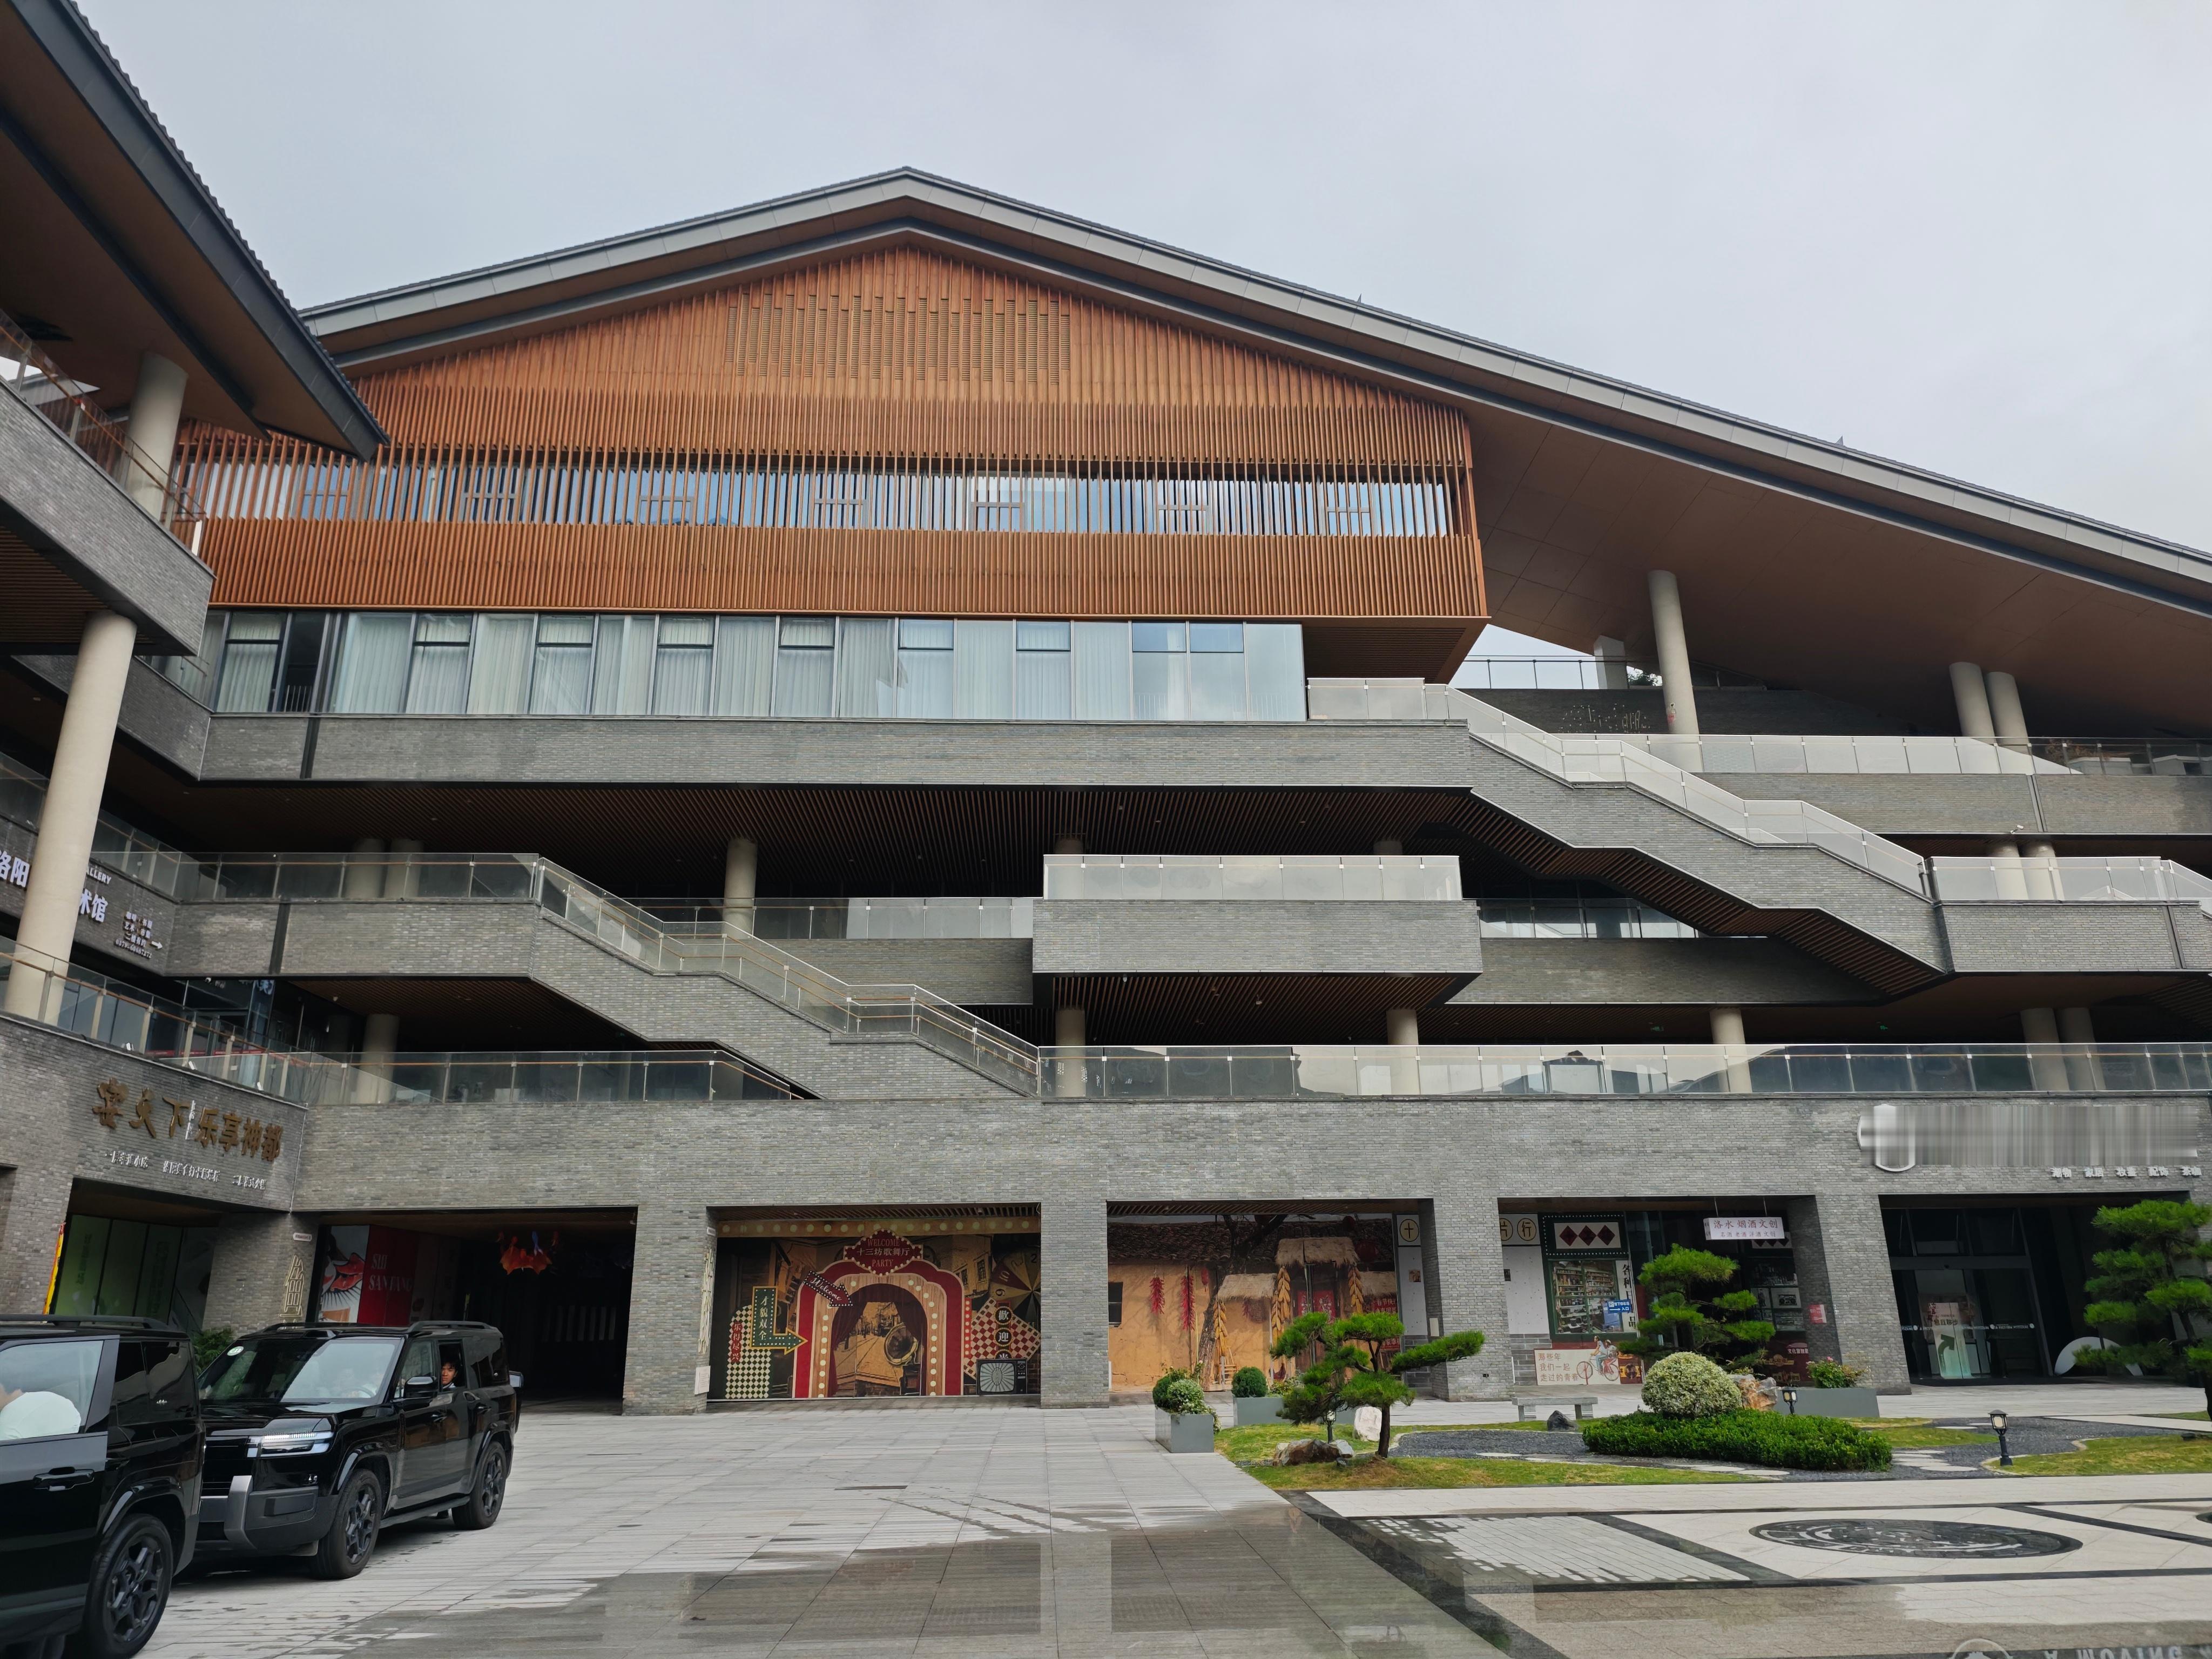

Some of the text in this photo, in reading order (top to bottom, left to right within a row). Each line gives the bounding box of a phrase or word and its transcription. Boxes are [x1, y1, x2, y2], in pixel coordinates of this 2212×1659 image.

[194, 1107, 283, 1162] 乐享神都
[857, 1248, 910, 1256] 十三坊歌舞厅
[872, 1259, 894, 1267] PARTY
[811, 1278, 842, 1300] Welcome
[759, 1296, 768, 1340] 才貌双全
[1538, 1353, 1561, 1361] 那些年
[1540, 1363, 1572, 1371] 我们一起
